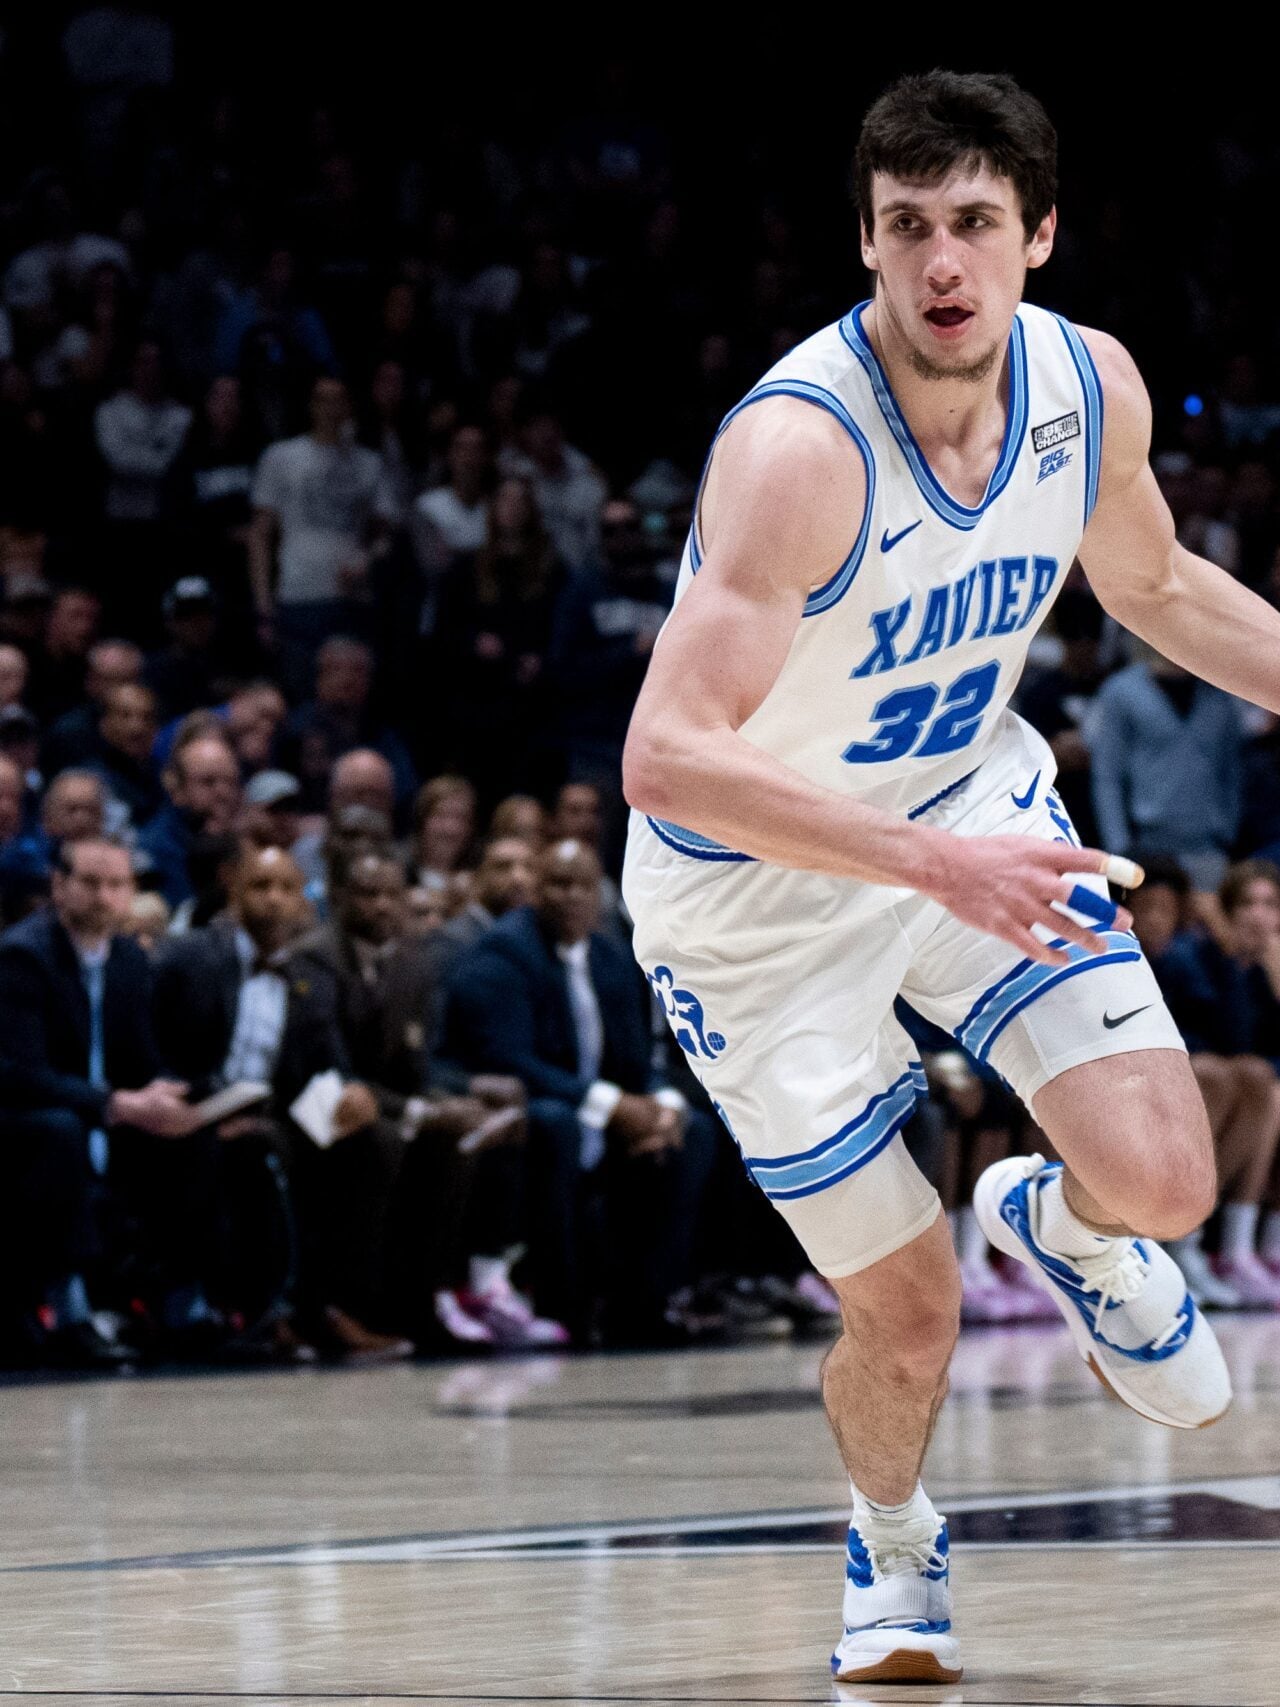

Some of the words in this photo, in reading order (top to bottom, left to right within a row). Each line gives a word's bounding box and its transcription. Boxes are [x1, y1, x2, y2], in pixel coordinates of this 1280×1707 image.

[1036, 425, 1079, 450] CHANGE
[1043, 420, 1064, 437] BE
[1037, 453, 1073, 481] EAST
[1040, 447, 1065, 468] BIG
[848, 554, 1059, 680] XAVIER
[840, 658, 1001, 764] 32
